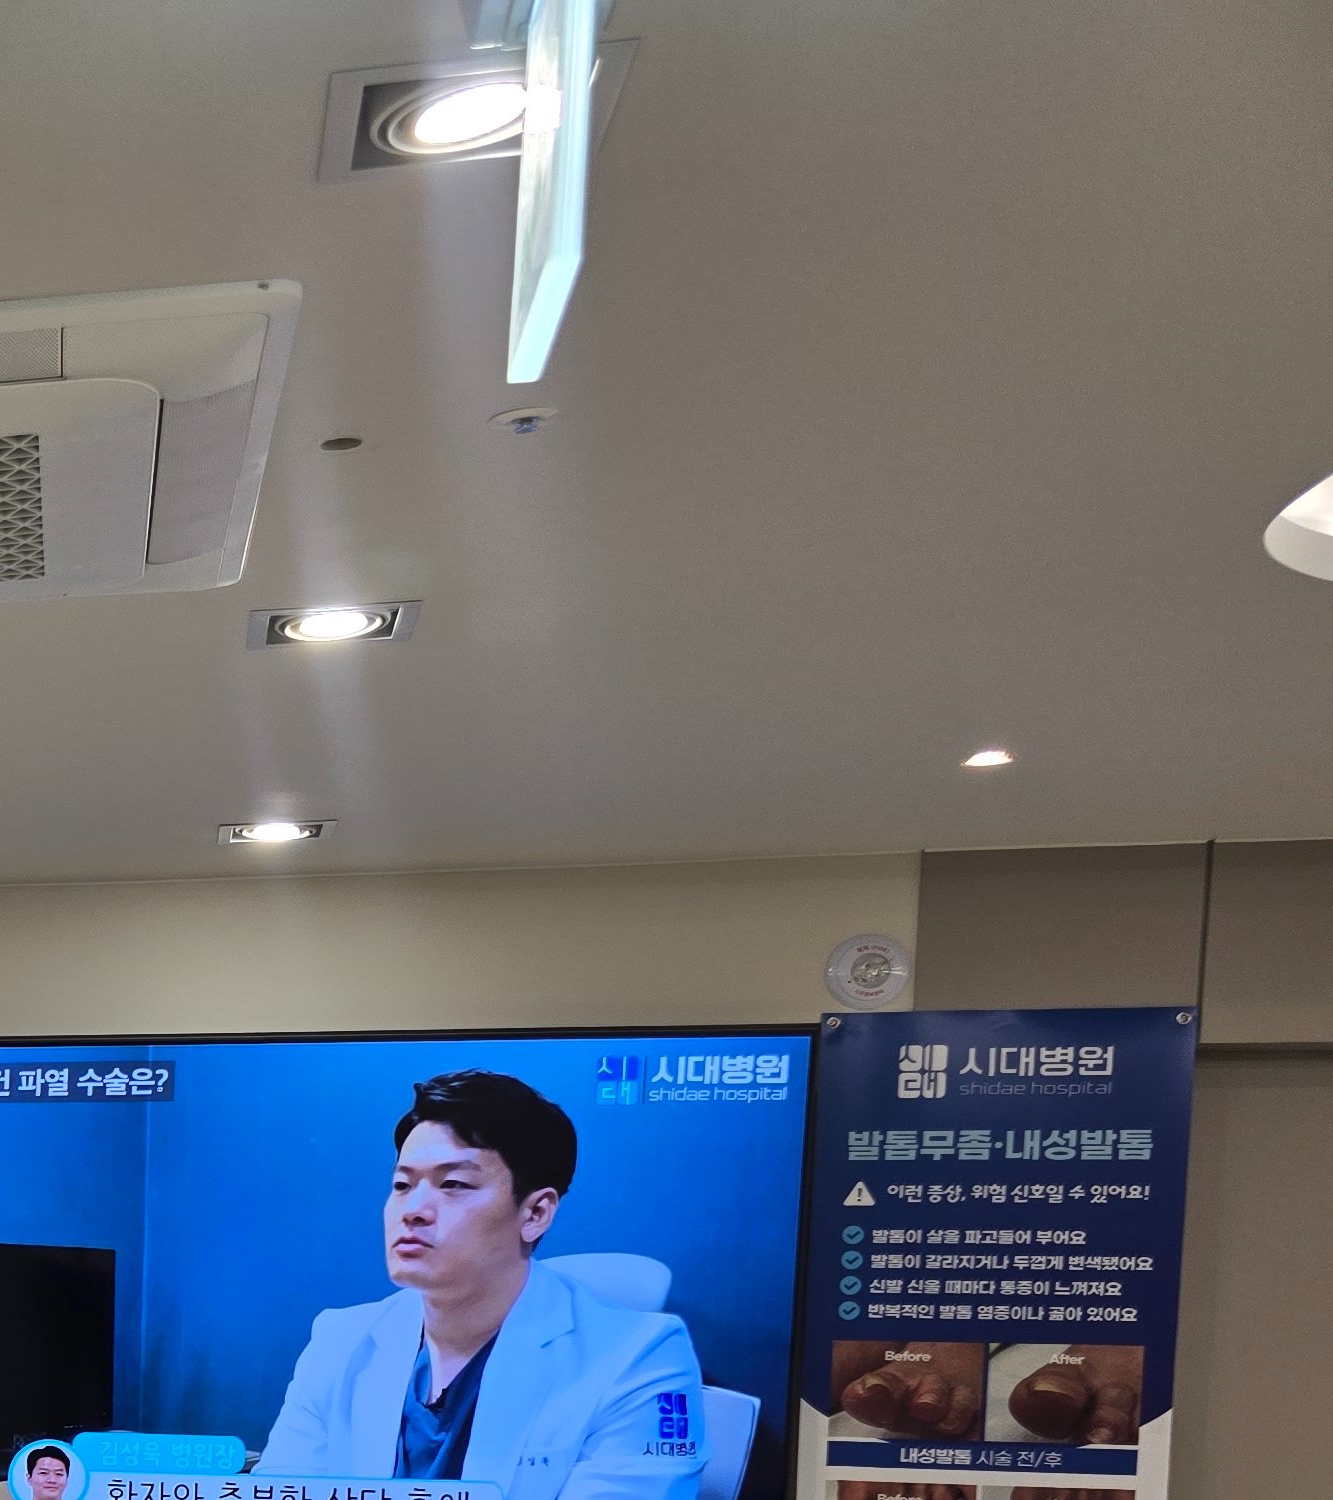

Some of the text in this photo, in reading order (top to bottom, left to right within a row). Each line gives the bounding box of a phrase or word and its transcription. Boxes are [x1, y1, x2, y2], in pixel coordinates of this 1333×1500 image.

[651, 1054, 790, 1085] 시대병원
[959, 1045, 1115, 1077] 시대병원
[17, 1067, 69, 1097] 파열
[76, 1066, 169, 1096] 수술은?
[959, 1081, 1114, 1097] shidae hospital
[649, 1086, 788, 1103] shidae hospital
[847, 1129, 1154, 1161] 발톱무좀·내성발톱
[887, 1184, 1151, 1204] 이런 증상, 위험 신호일 수 있어요!
[872, 1229, 1086, 1245] 발톱이 살을 파고들어 부어요
[870, 1254, 1154, 1271] 발톱이 갈라지거나 두껍게 변색됐어요
[869, 1279, 1122, 1297] 신발 신을 때마다 통증이 느껴져요
[867, 1304, 1138, 1323] 반복적인 발톱 염증이나 곪아 있어요
[884, 1351, 931, 1362] Before
[1049, 1354, 1084, 1365] After
[101, 1441, 237, 1469] 김성욱 병원장
[900, 1448, 1063, 1468] 내성발톱 시술 전/후
